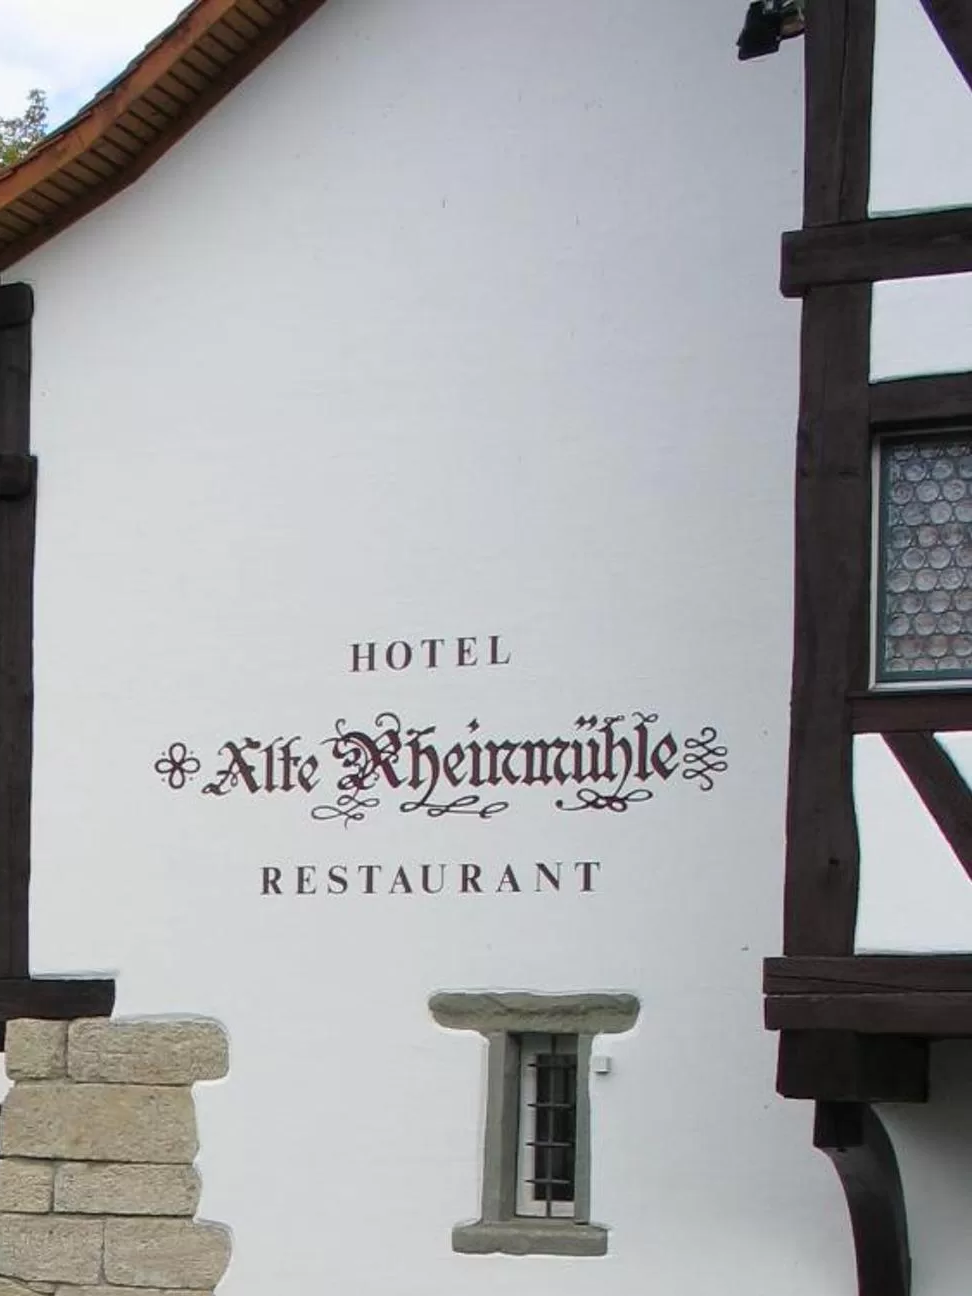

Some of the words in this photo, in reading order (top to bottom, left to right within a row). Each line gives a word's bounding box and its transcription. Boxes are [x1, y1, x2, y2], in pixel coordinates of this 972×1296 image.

[349, 635, 512, 673] HOTEL
[201, 735, 321, 796] Alte
[316, 711, 681, 823] Rheinmühle
[260, 861, 602, 895] RESTAURANT
